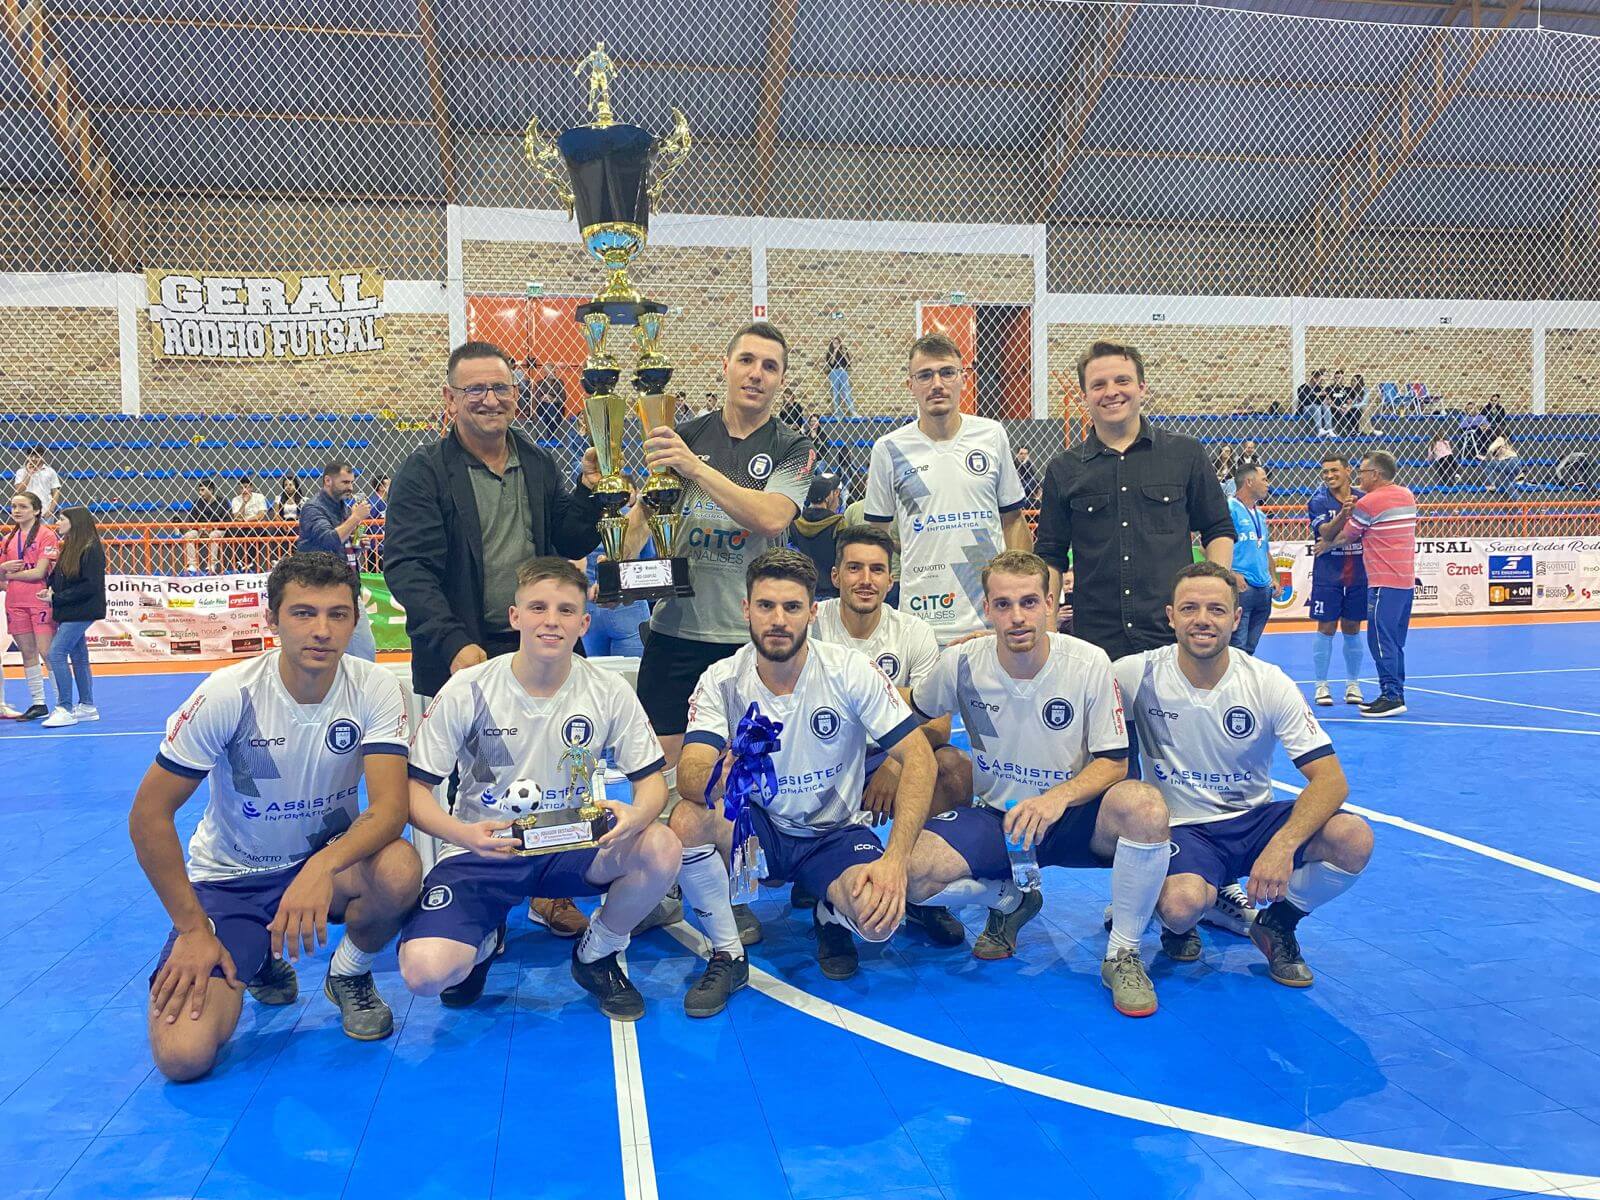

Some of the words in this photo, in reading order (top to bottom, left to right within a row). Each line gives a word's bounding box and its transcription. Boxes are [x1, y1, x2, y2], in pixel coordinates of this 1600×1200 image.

[160, 274, 378, 315] GERAL
[161, 319, 266, 357] RODEIO
[270, 315, 384, 357] FUTSAL
[926, 510, 993, 525] ASSISTEC
[105, 581, 162, 593] olinha
[167, 582, 230, 594] Rodeio
[1314, 601, 1325, 613] 21
[778, 763, 843, 786] SSISTEC
[992, 759, 1074, 781] ASSISTEC
[1171, 767, 1252, 783] ASSISTEC
[266, 785, 358, 813] ASSISTEC
